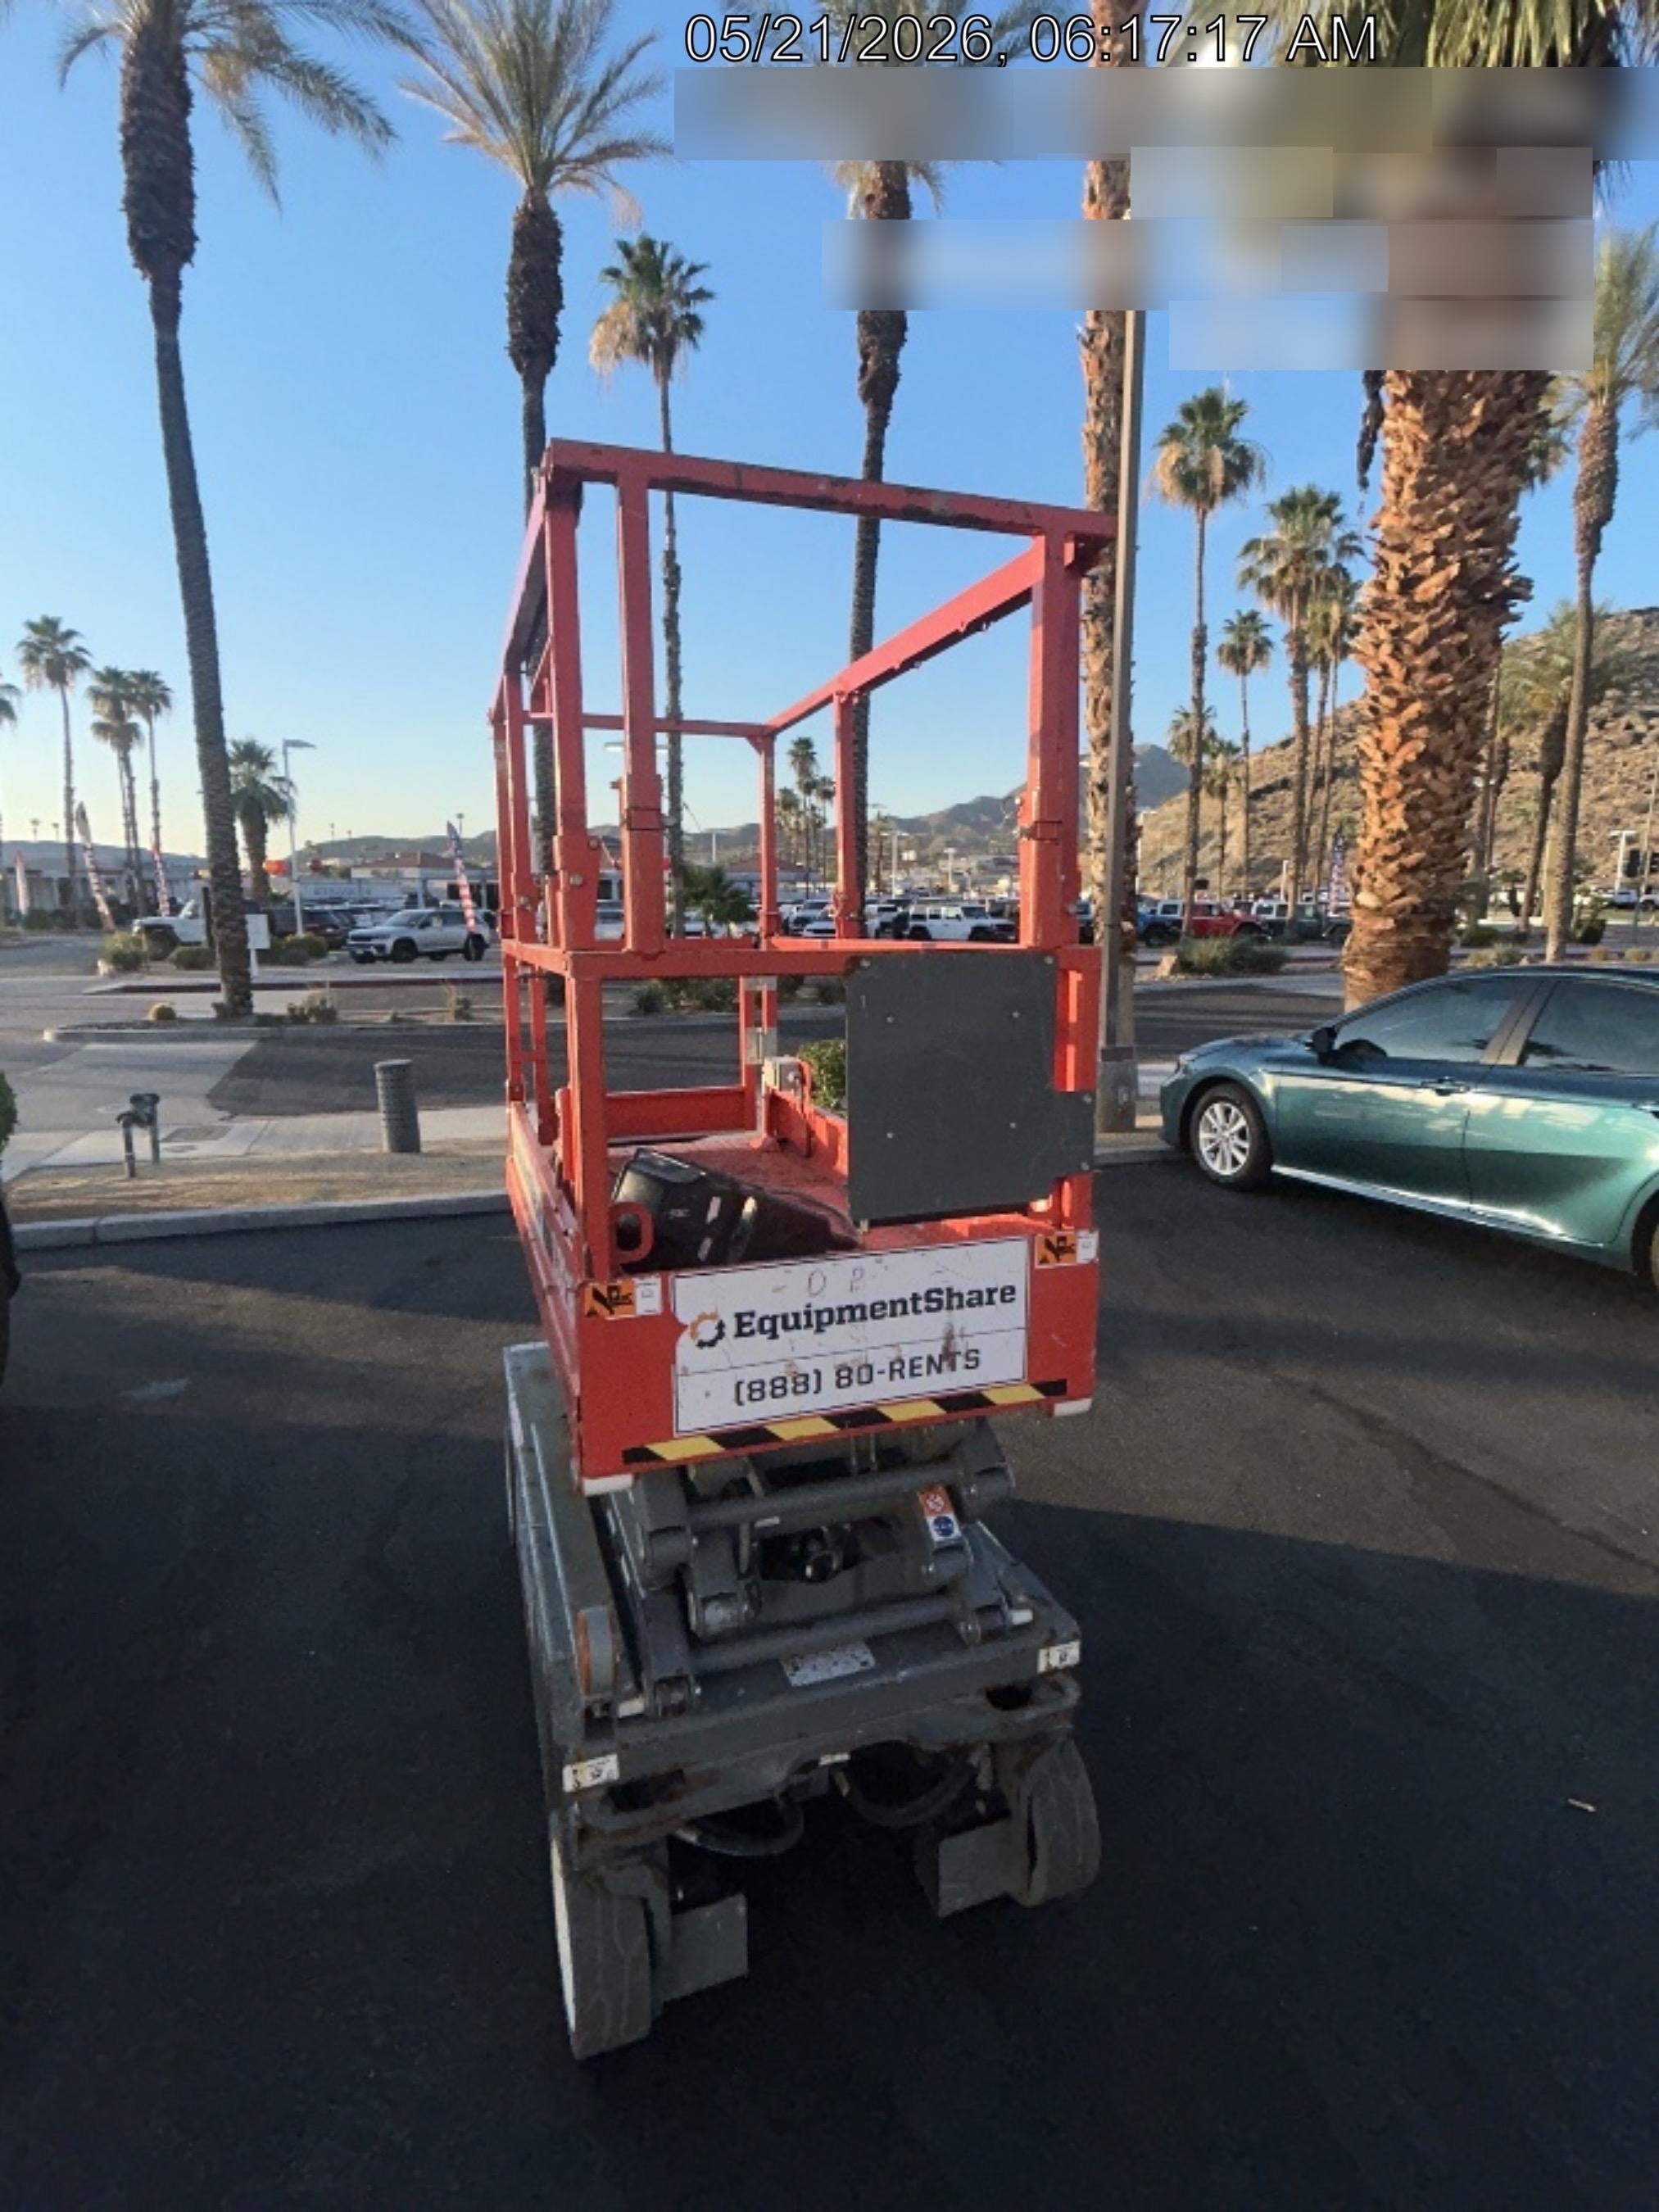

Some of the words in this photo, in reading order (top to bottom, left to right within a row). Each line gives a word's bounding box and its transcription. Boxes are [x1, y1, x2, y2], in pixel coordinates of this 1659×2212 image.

[733, 1284, 1017, 1341] EquipmentShare
[734, 1368, 823, 1406] (888)
[834, 1349, 981, 1390] 80-RENTS
